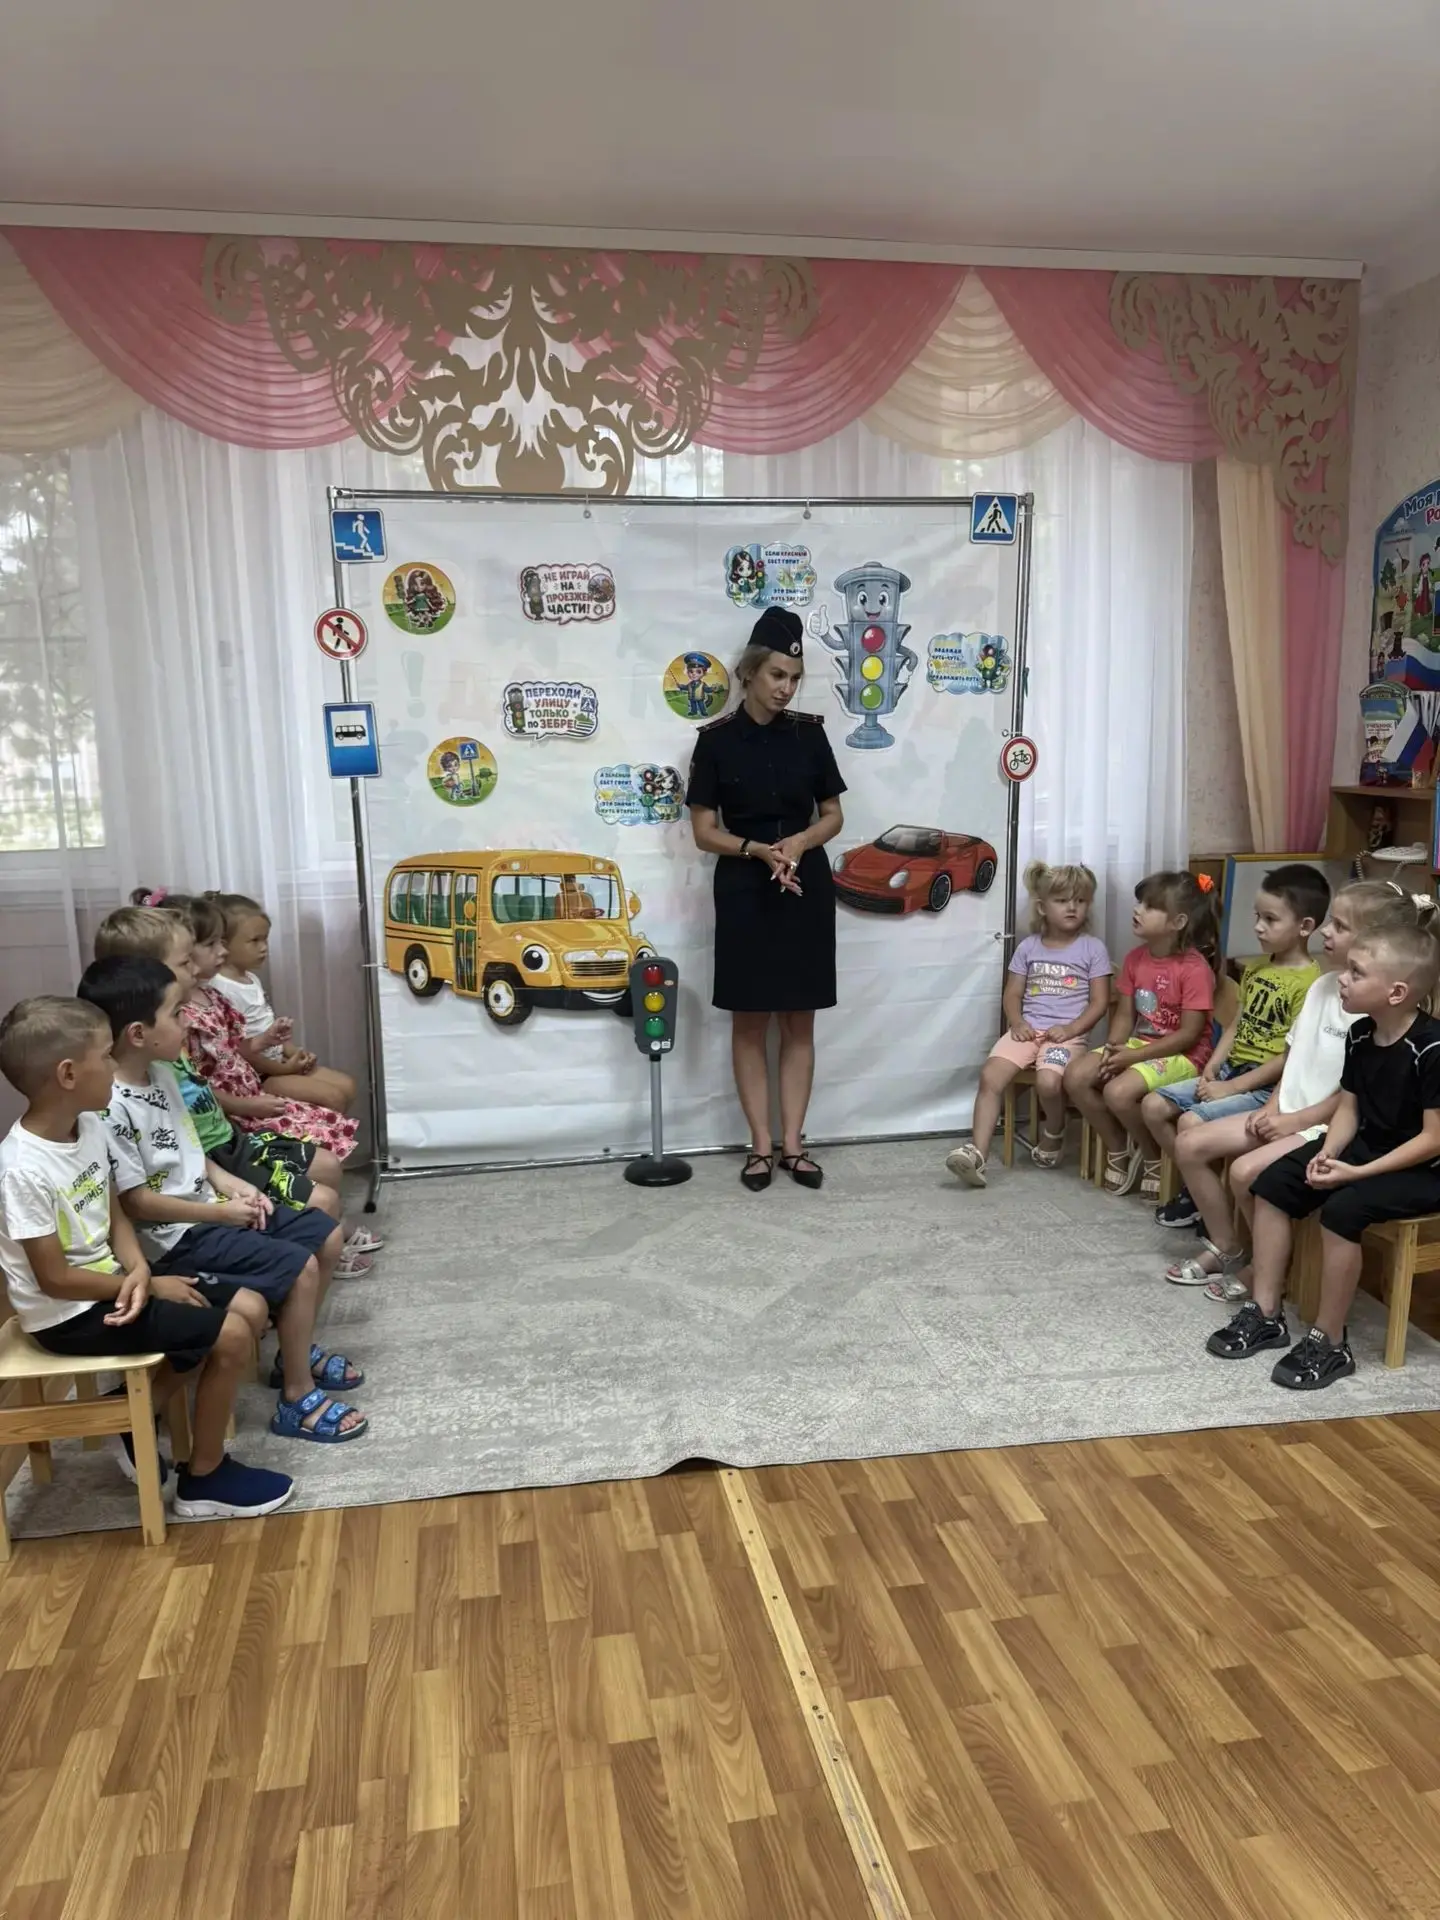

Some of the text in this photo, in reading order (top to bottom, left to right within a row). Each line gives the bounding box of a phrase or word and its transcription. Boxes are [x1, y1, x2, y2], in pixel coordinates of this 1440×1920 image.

[1404, 492, 1434, 519] Моя
[543, 570, 591, 582] НЕ ИГРАЙ
[560, 581, 575, 591] НА
[547, 603, 590, 615] ЧАСТИ!
[525, 687, 581, 699] ПЕРЕХОДИ
[534, 699, 571, 709] УЛИЦУ
[529, 709, 569, 718] ТОЛЬКО
[540, 719, 577, 729] ЗЕБРЕ!
